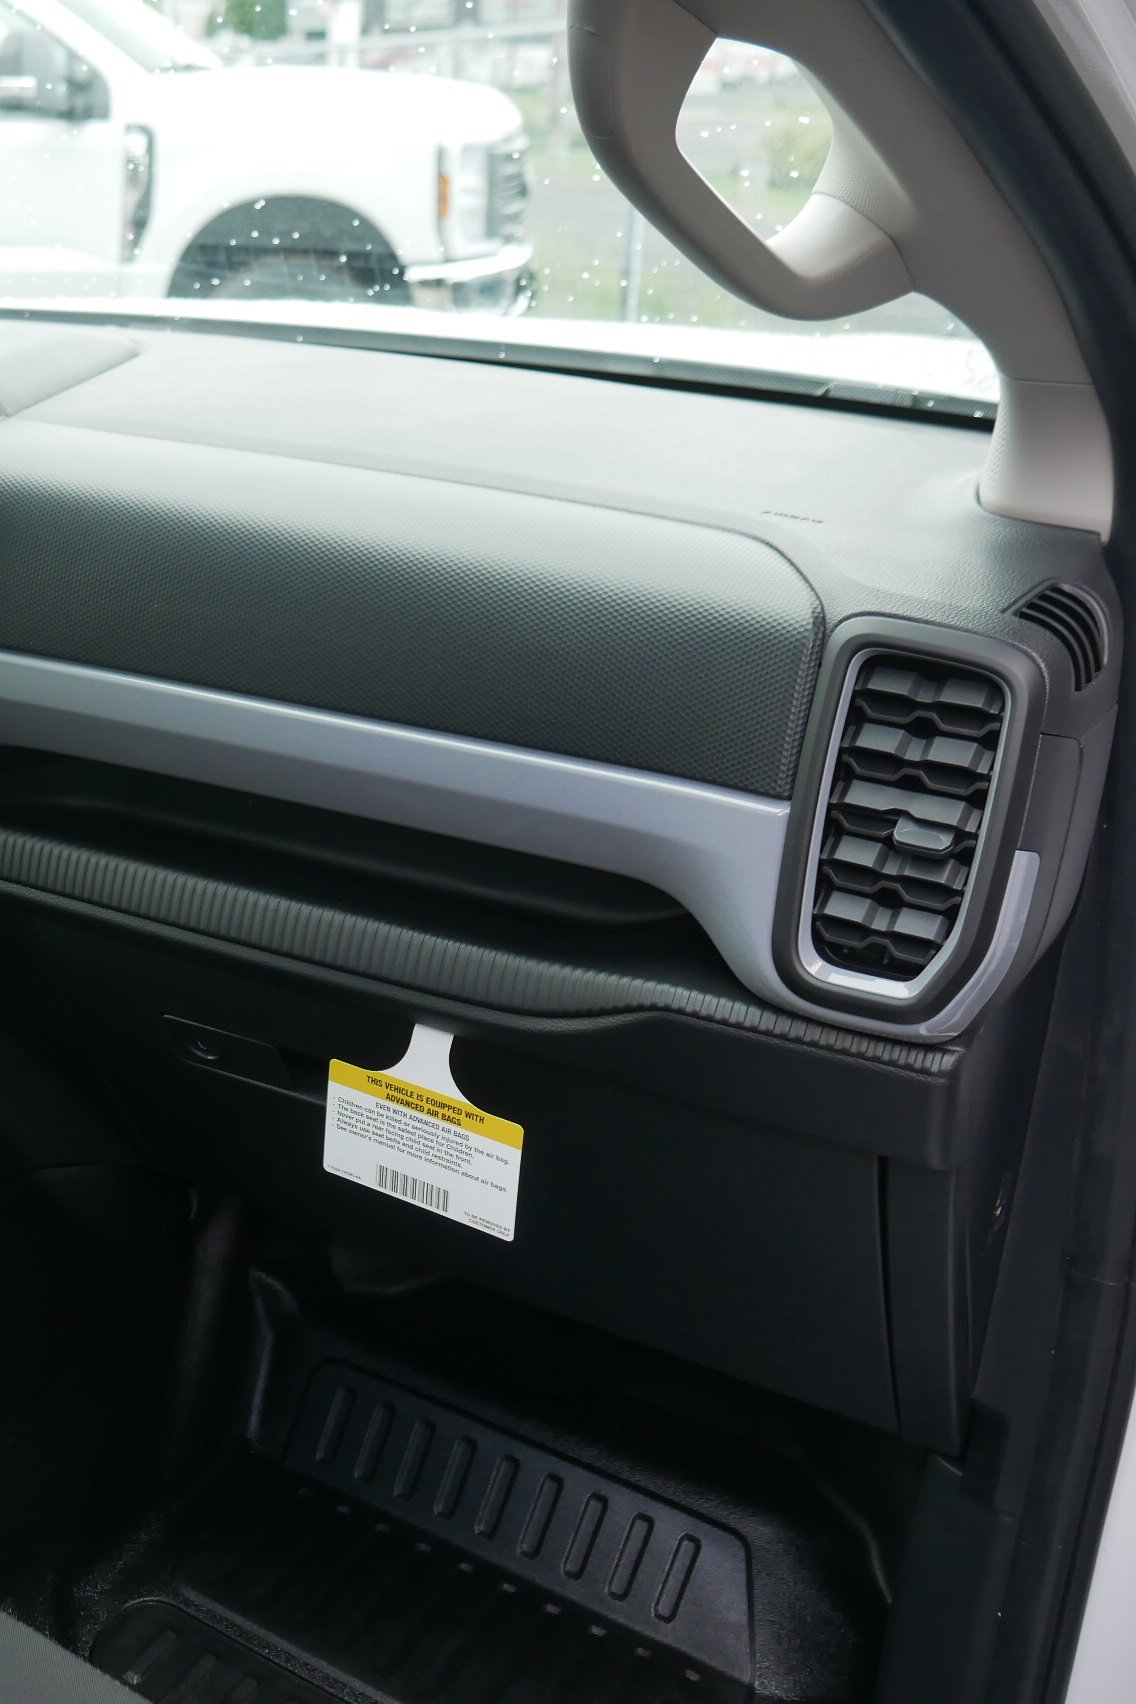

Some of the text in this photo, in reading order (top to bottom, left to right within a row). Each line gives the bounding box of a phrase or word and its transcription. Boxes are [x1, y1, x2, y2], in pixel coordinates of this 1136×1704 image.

[366, 1075, 484, 1124] THIS VEHICLE IS EQUIPPED WITH
[375, 1102, 469, 1141] EVEN WITH ADVANCED AIR BAGS
[385, 1092, 461, 1126] ADVANCED AIR BAGS
[336, 1117, 463, 1168] Always use seat belts and child restraints.
[337, 1103, 348, 1112] The
[350, 1108, 364, 1118] back
[365, 1114, 378, 1123] seat
[386, 1121, 396, 1129] the
[397, 1125, 416, 1137] safest
[417, 1133, 434, 1144] place
[446, 1143, 474, 1159] Children.
[337, 1110, 354, 1121] Never
[355, 1117, 365, 1126] put
[373, 1124, 384, 1132] rear
[385, 1128, 404, 1140] facing
[405, 1135, 420, 1145] child
[422, 1141, 435, 1151] seat
[444, 1149, 454, 1158] the
[455, 1154, 472, 1165] front.
[338, 1096, 363, 1111] Children
[364, 1107, 375, 1115] can
[385, 1114, 402, 1125] killed
[412, 1124, 439, 1140] seriously
[441, 1135, 463, 1148] injured
[464, 1143, 472, 1151] by
[474, 1147, 484, 1155] the
[486, 1151, 494, 1159] air
[495, 1155, 509, 1166] bag.
[336, 1123, 347, 1132] See
[348, 1128, 372, 1141] owner's
[373, 1137, 396, 1150] manual
[396, 1146, 405, 1154] for
[406, 1150, 422, 1160] more
[424, 1156, 459, 1174] information
[461, 1170, 479, 1182] about
[490, 1181, 508, 1193] bags.
